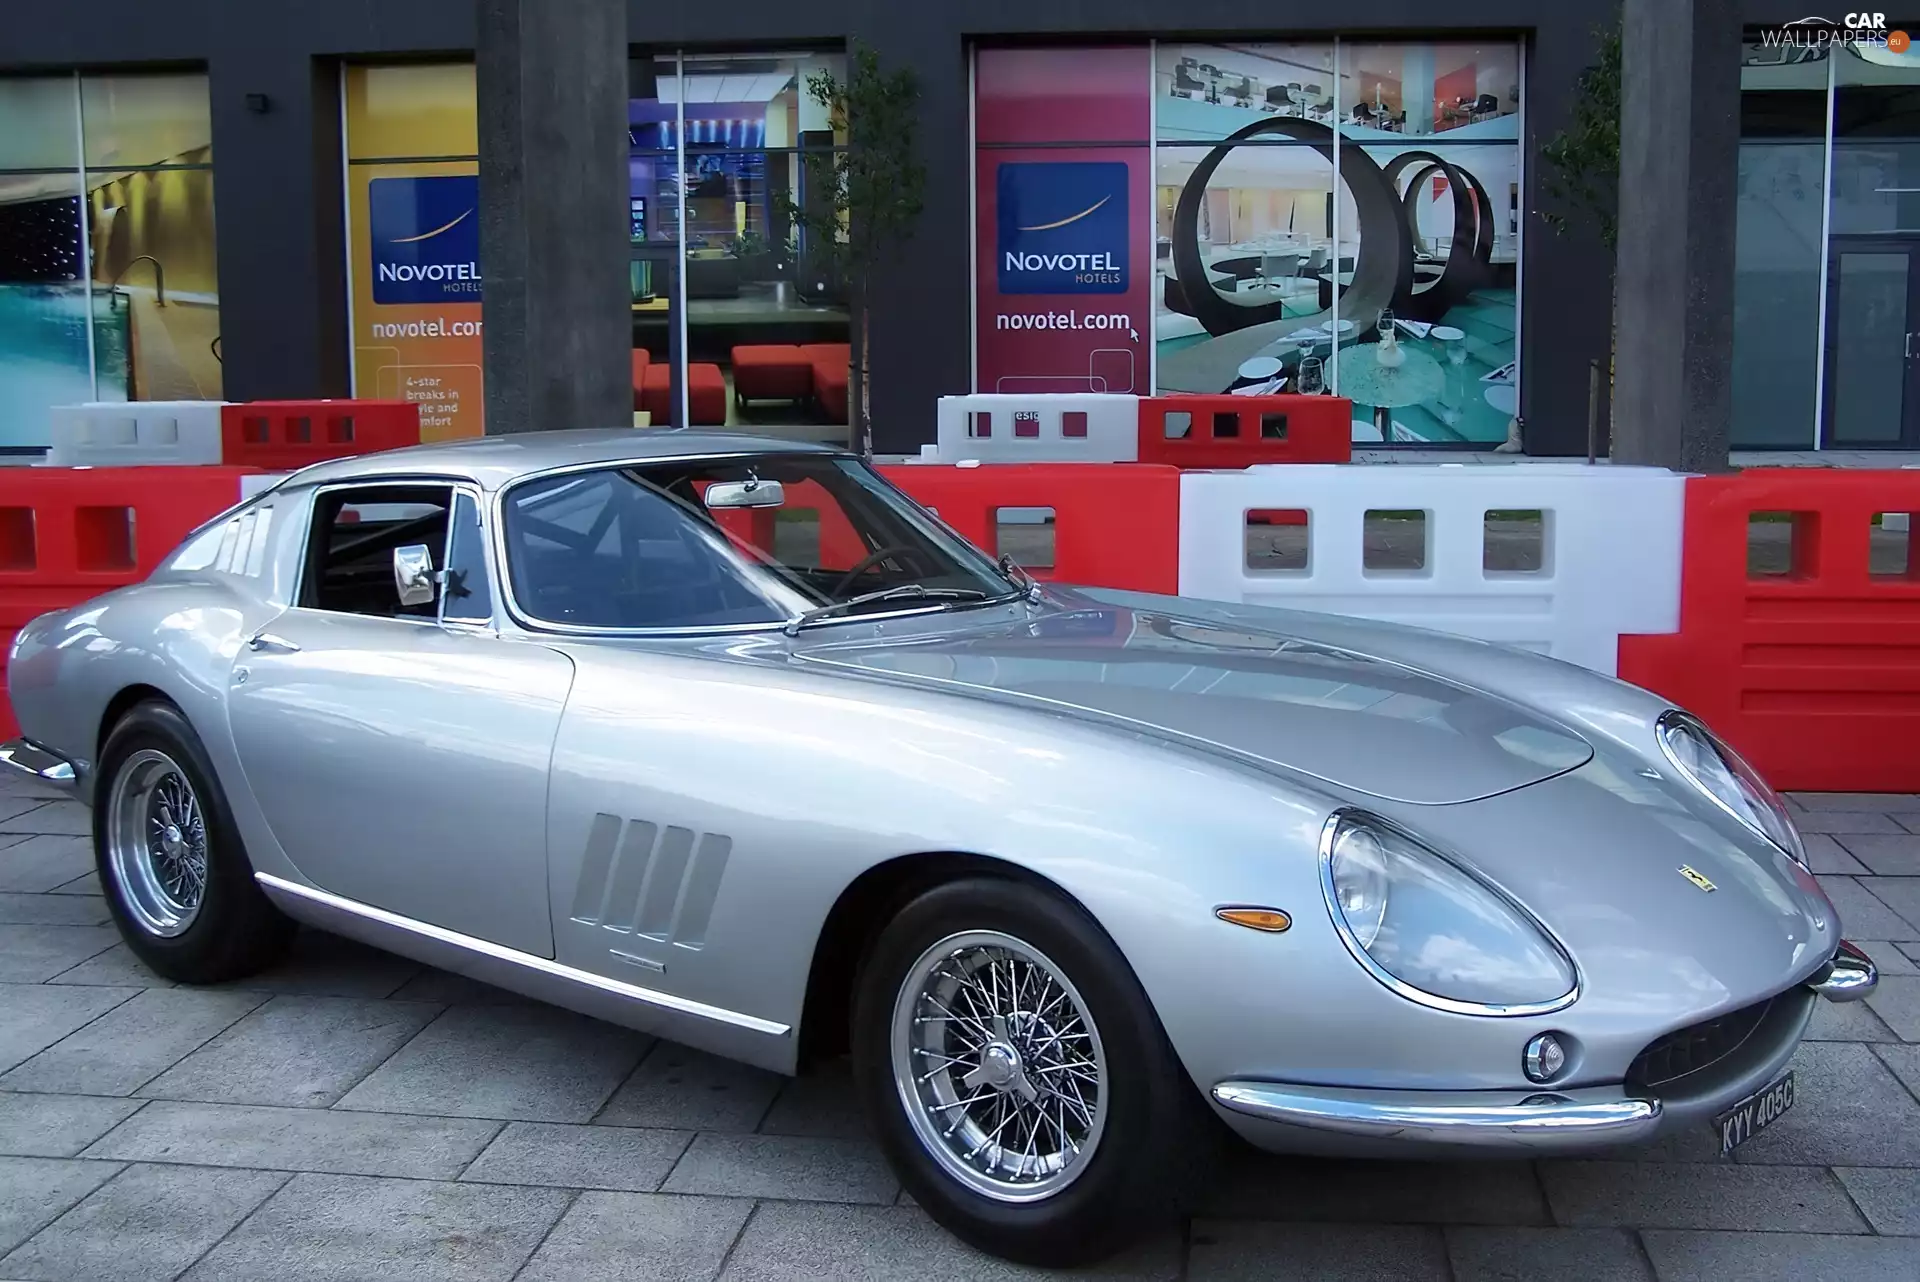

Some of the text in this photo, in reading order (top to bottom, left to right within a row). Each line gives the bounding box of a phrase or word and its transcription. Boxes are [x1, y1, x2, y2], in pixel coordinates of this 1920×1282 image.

[1005, 251, 1121, 271] NOVOTEL
[1075, 273, 1121, 284] HOTELS
[996, 309, 1130, 330] novotel.com
[406, 376, 442, 387] 4-star
[406, 388, 459, 400] breaks in
[437, 402, 458, 413] and
[1723, 1079, 1793, 1152] KYY 405C
